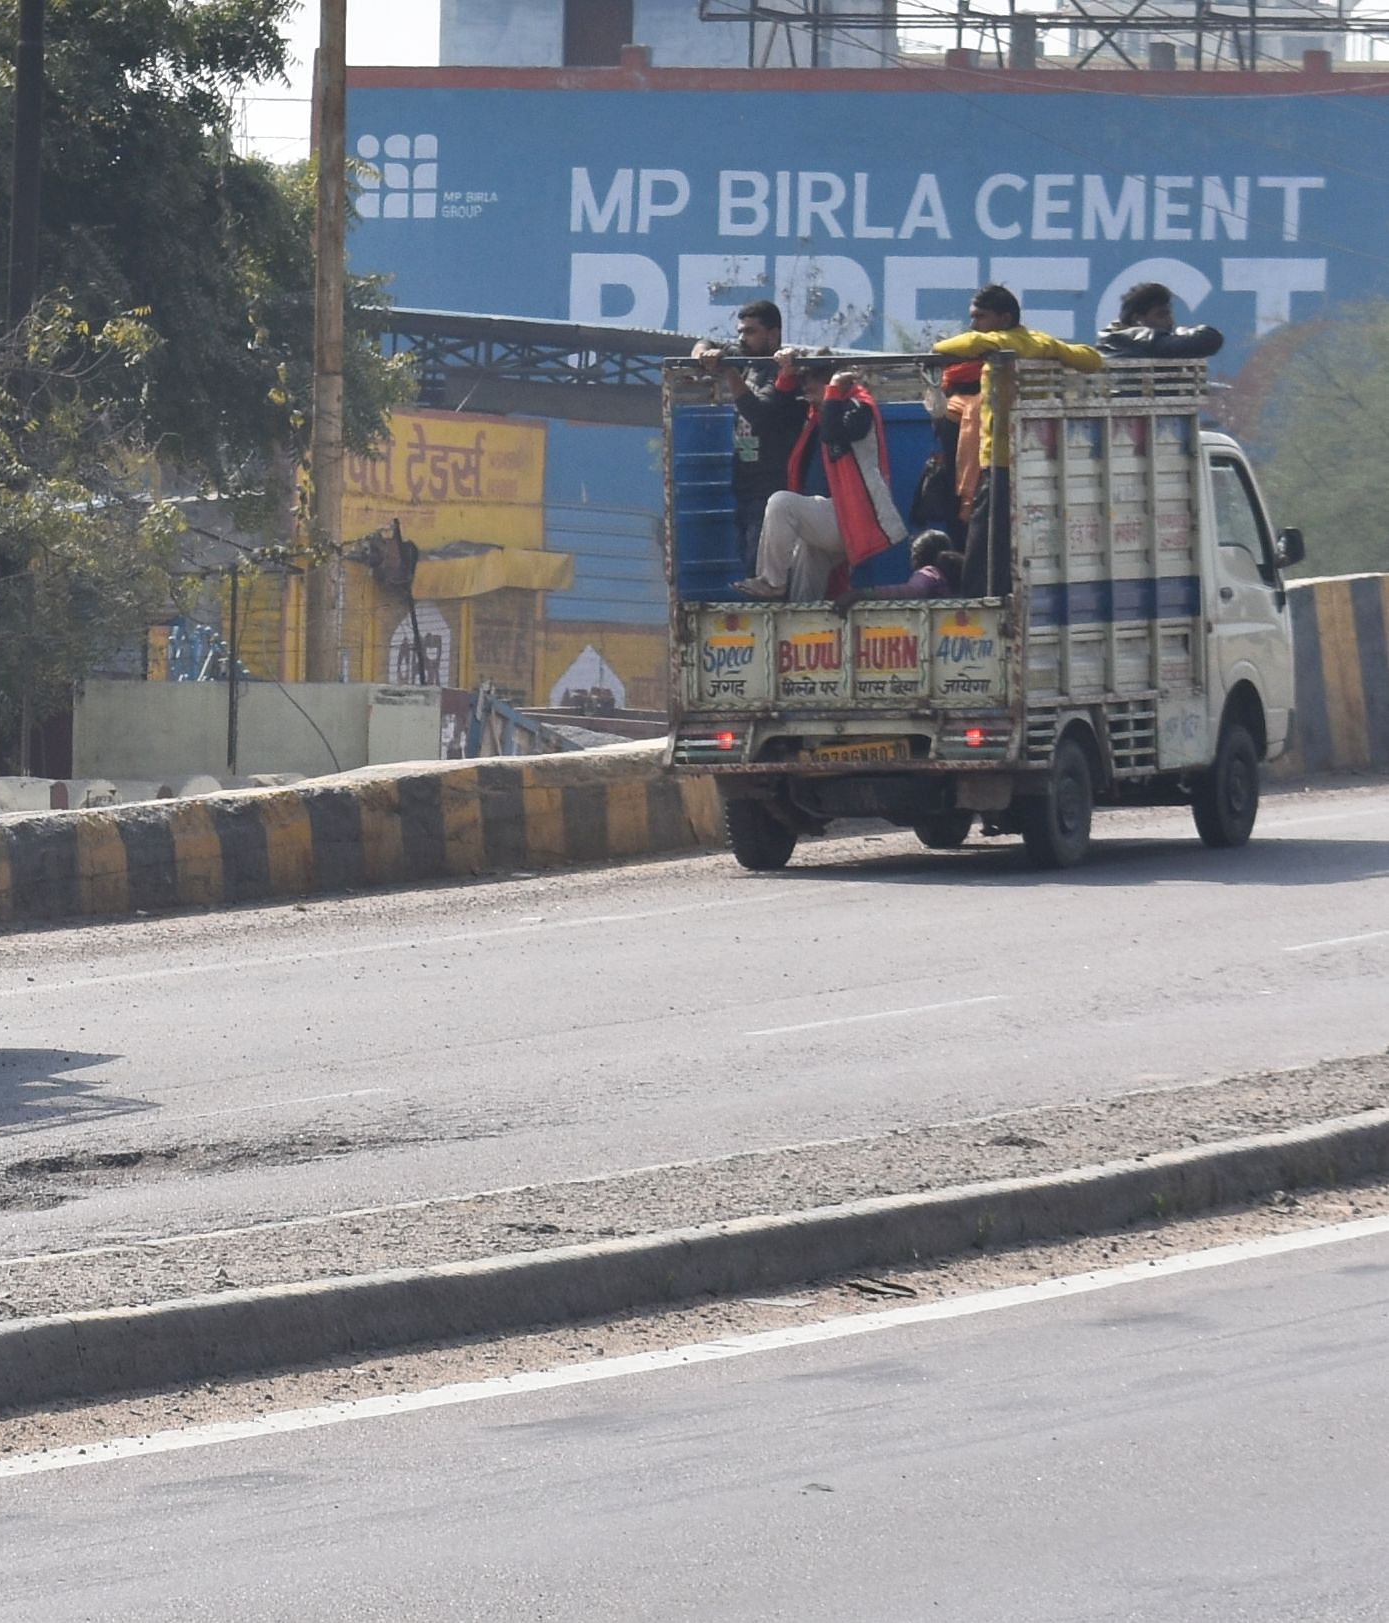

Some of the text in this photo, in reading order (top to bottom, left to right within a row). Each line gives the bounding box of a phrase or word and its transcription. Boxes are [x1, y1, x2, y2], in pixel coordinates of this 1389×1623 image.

[441, 205, 483, 219] GROUP
[443, 191, 499, 203] MP BIRLA
[570, 167, 1325, 242] MP BIRLA CEMENT
[778, 626, 843, 674] BLOW
[853, 625, 919, 670] HORN
[706, 679, 747, 698] जगह
